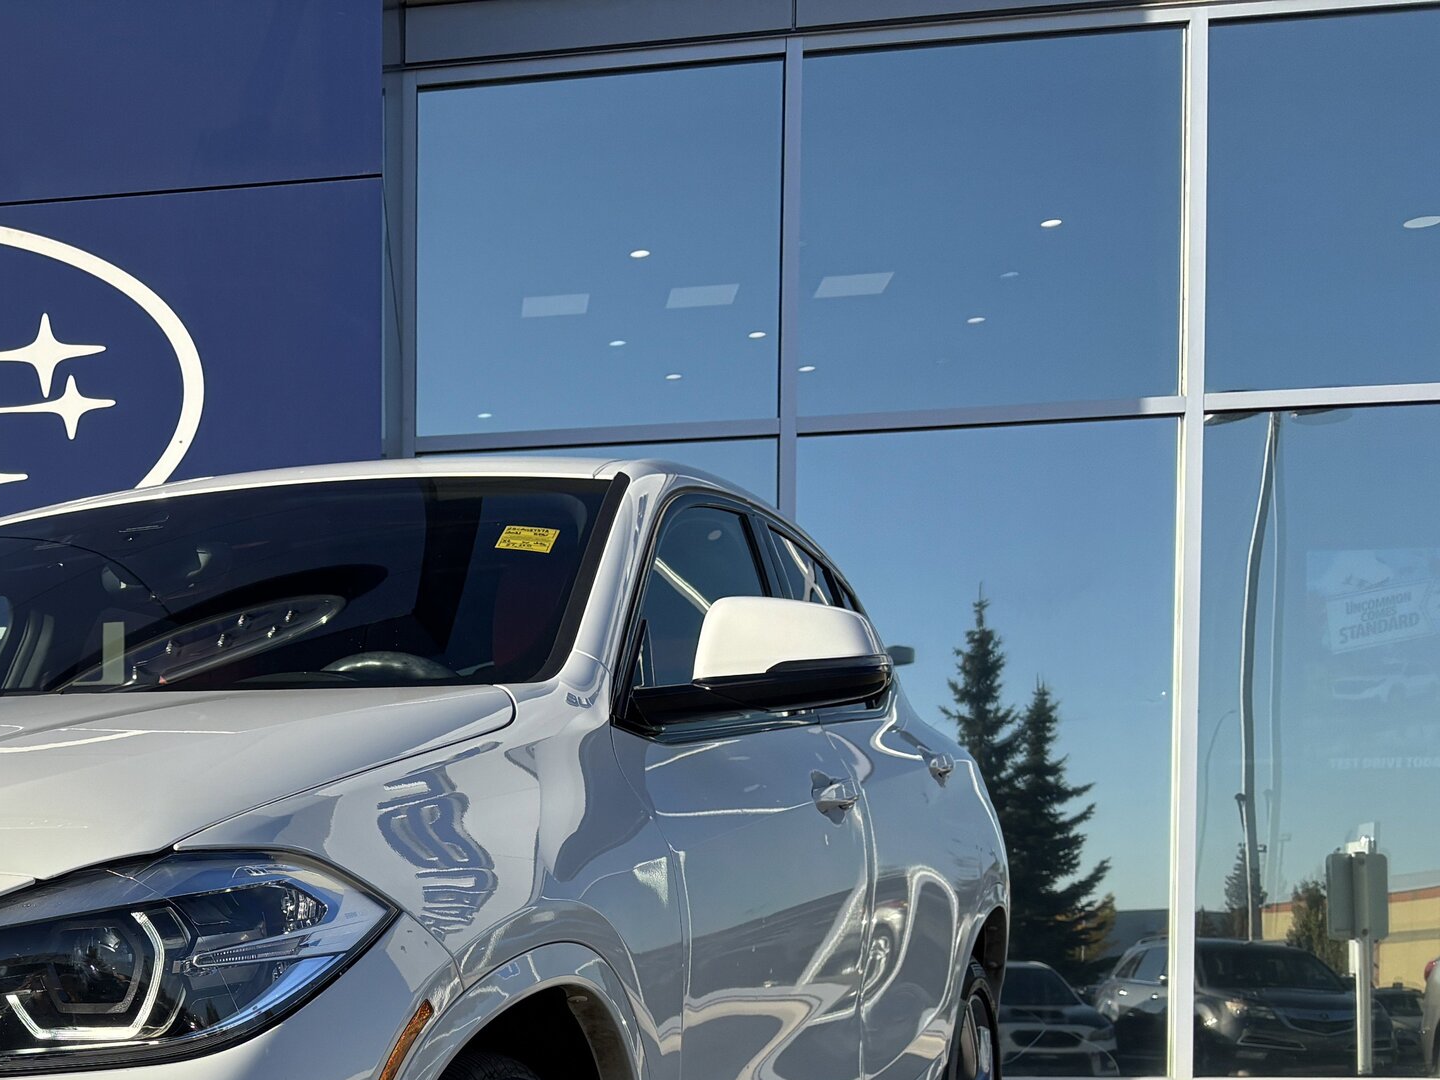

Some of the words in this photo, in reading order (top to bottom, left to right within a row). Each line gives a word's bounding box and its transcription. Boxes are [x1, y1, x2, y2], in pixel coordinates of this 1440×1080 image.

[1345, 592, 1412, 615] UNCOMMON
[1360, 606, 1397, 623] COMES
[1339, 612, 1420, 644] STANDARD
[1363, 758, 1402, 769] DRIVE
